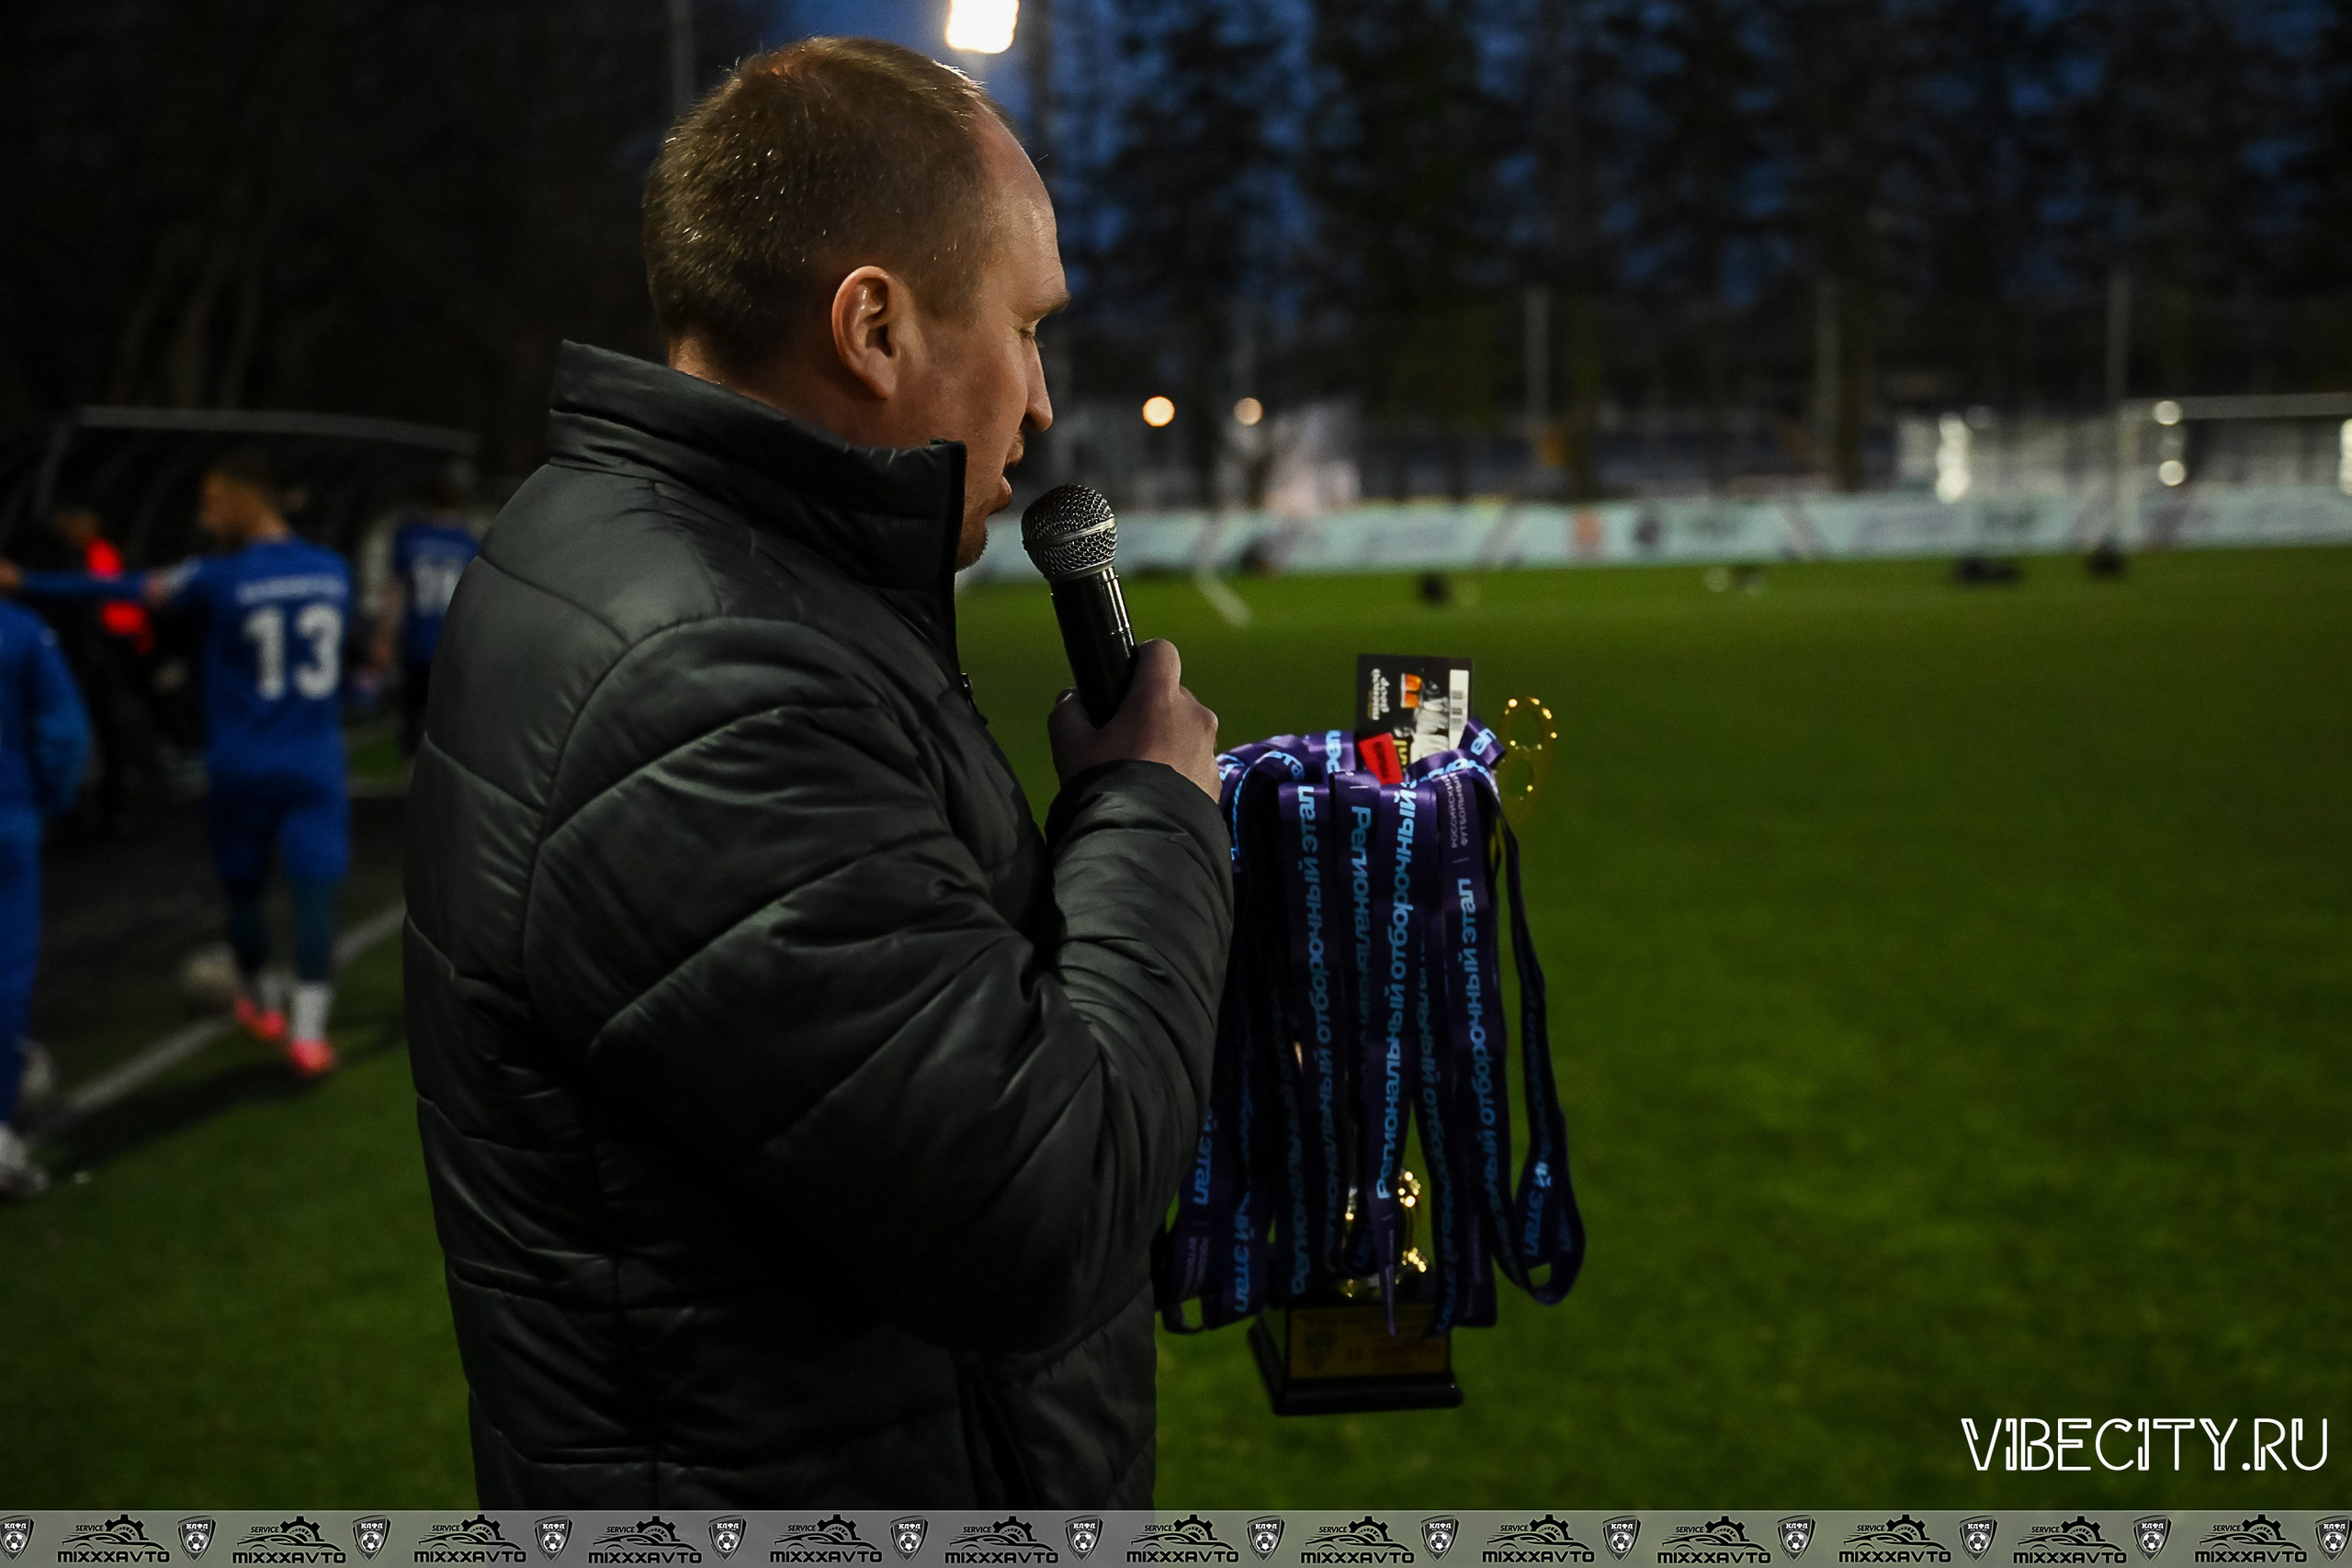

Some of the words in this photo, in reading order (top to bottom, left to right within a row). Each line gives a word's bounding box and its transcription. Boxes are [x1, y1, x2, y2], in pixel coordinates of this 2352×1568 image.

[243, 604, 344, 701] 13
[1298, 784, 1318, 855] этап
[1387, 789, 1417, 981] отборочный
[1298, 857, 1331, 1044] отборочный
[1458, 877, 1478, 944] этап
[1376, 984, 1406, 1199] Региональный
[1458, 947, 1497, 1128] отборочный
[1193, 1137, 1214, 1206] этап
